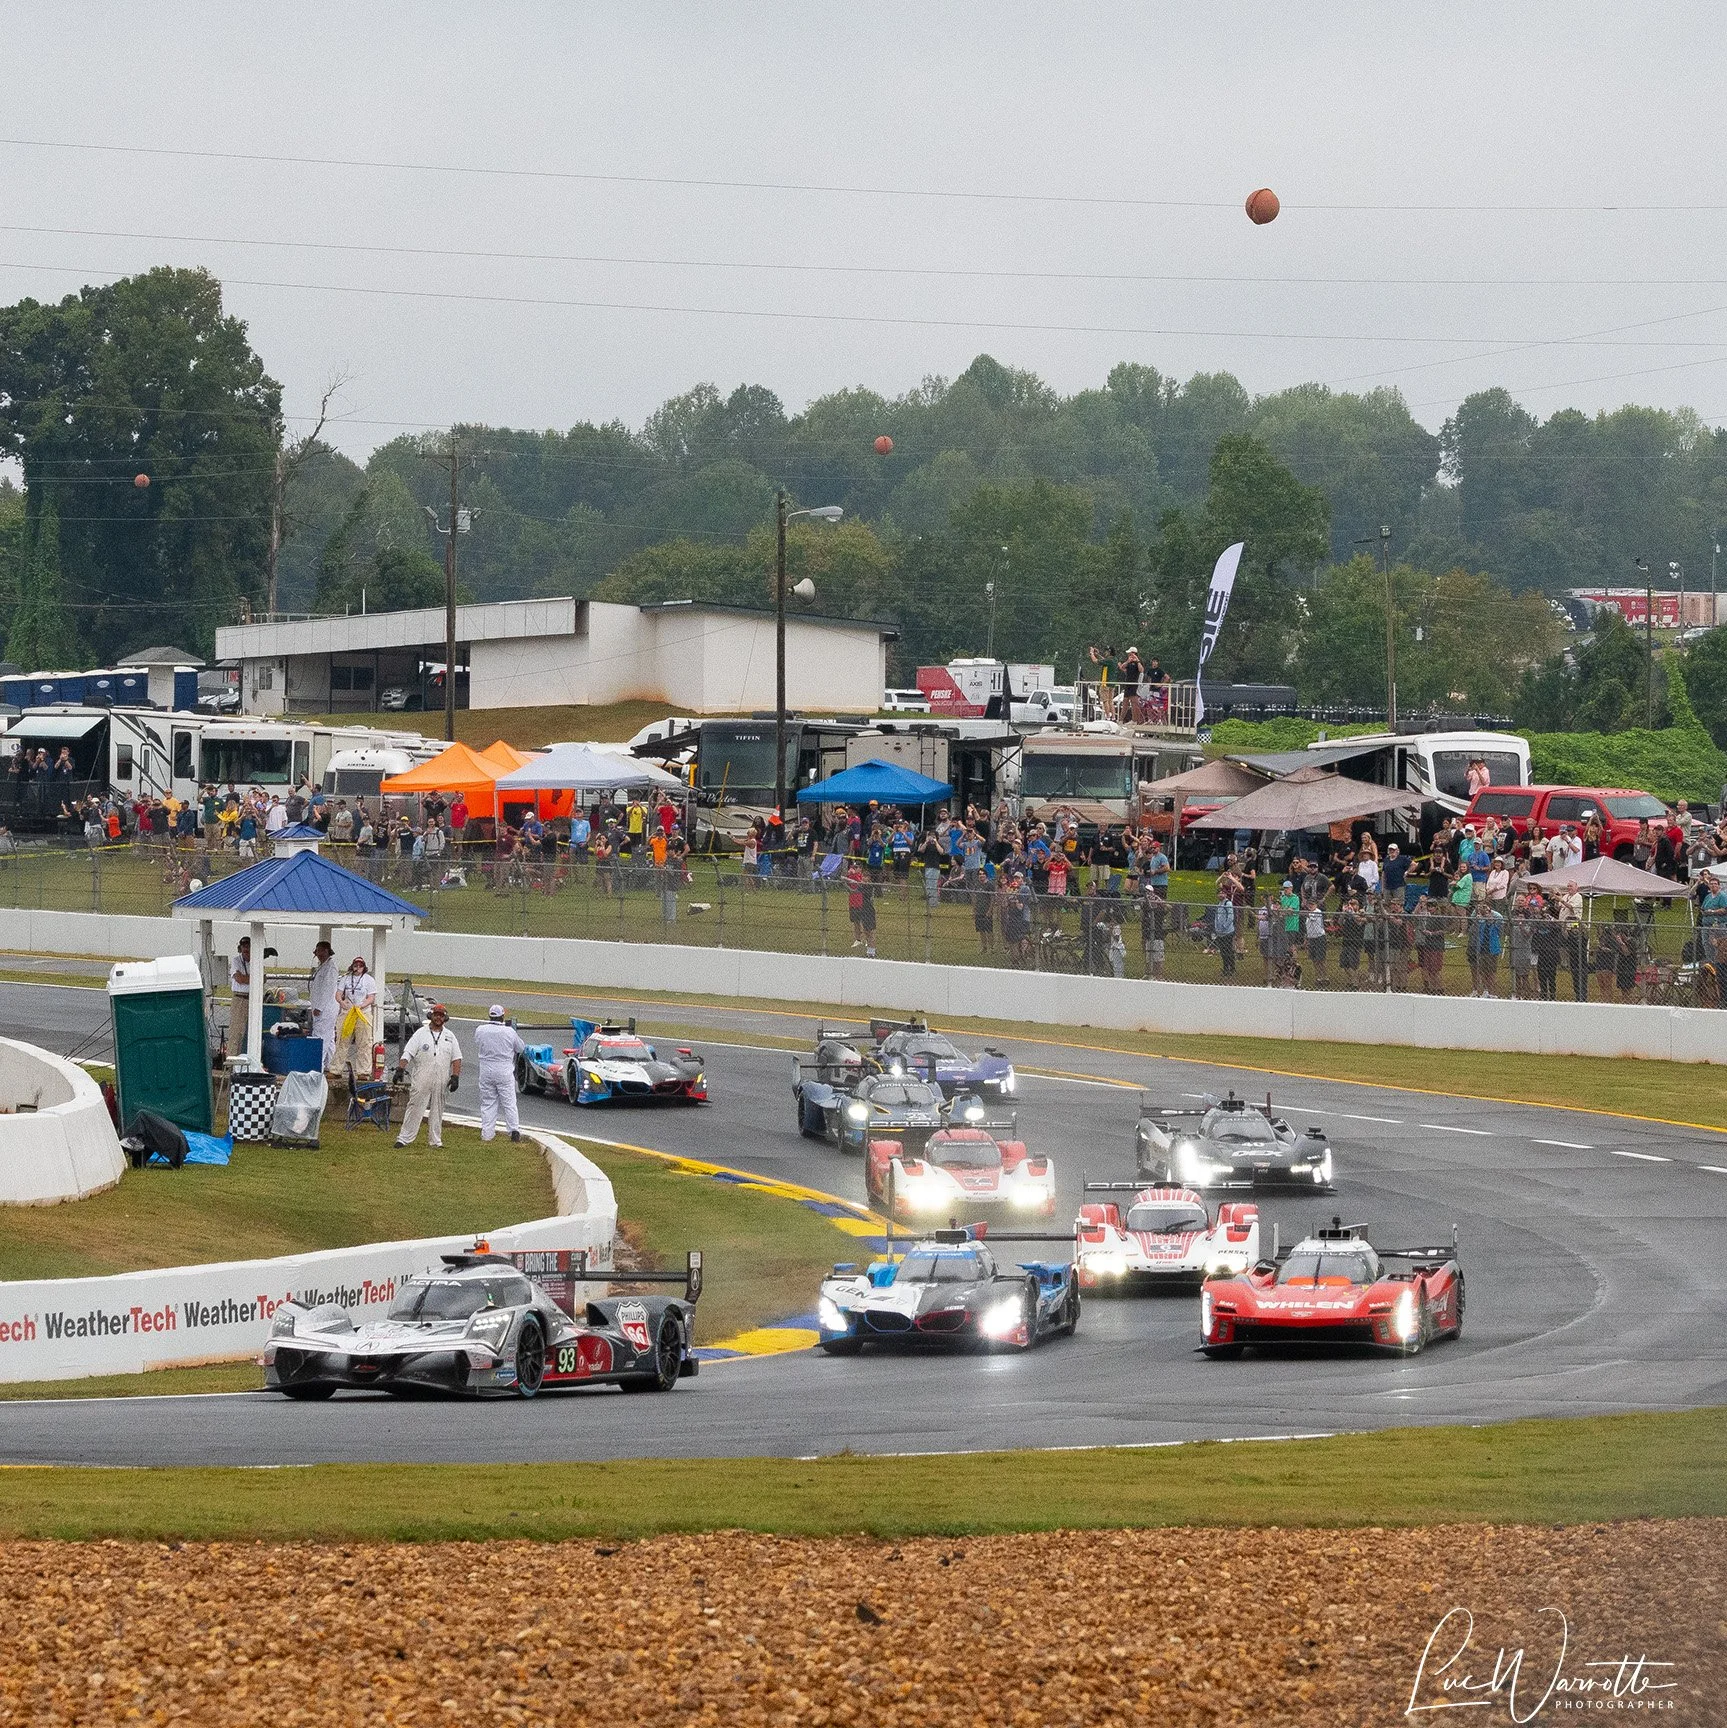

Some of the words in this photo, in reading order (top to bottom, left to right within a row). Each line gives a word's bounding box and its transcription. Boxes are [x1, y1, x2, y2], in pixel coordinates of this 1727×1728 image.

[930, 689, 952, 699] PENSKE
[525, 1253, 545, 1272] BRING
[1255, 1300, 1355, 1309] WHELEN
[621, 1310, 646, 1322] PHILLIPS
[627, 1326, 646, 1345] 66
[558, 1348, 576, 1373] 93
